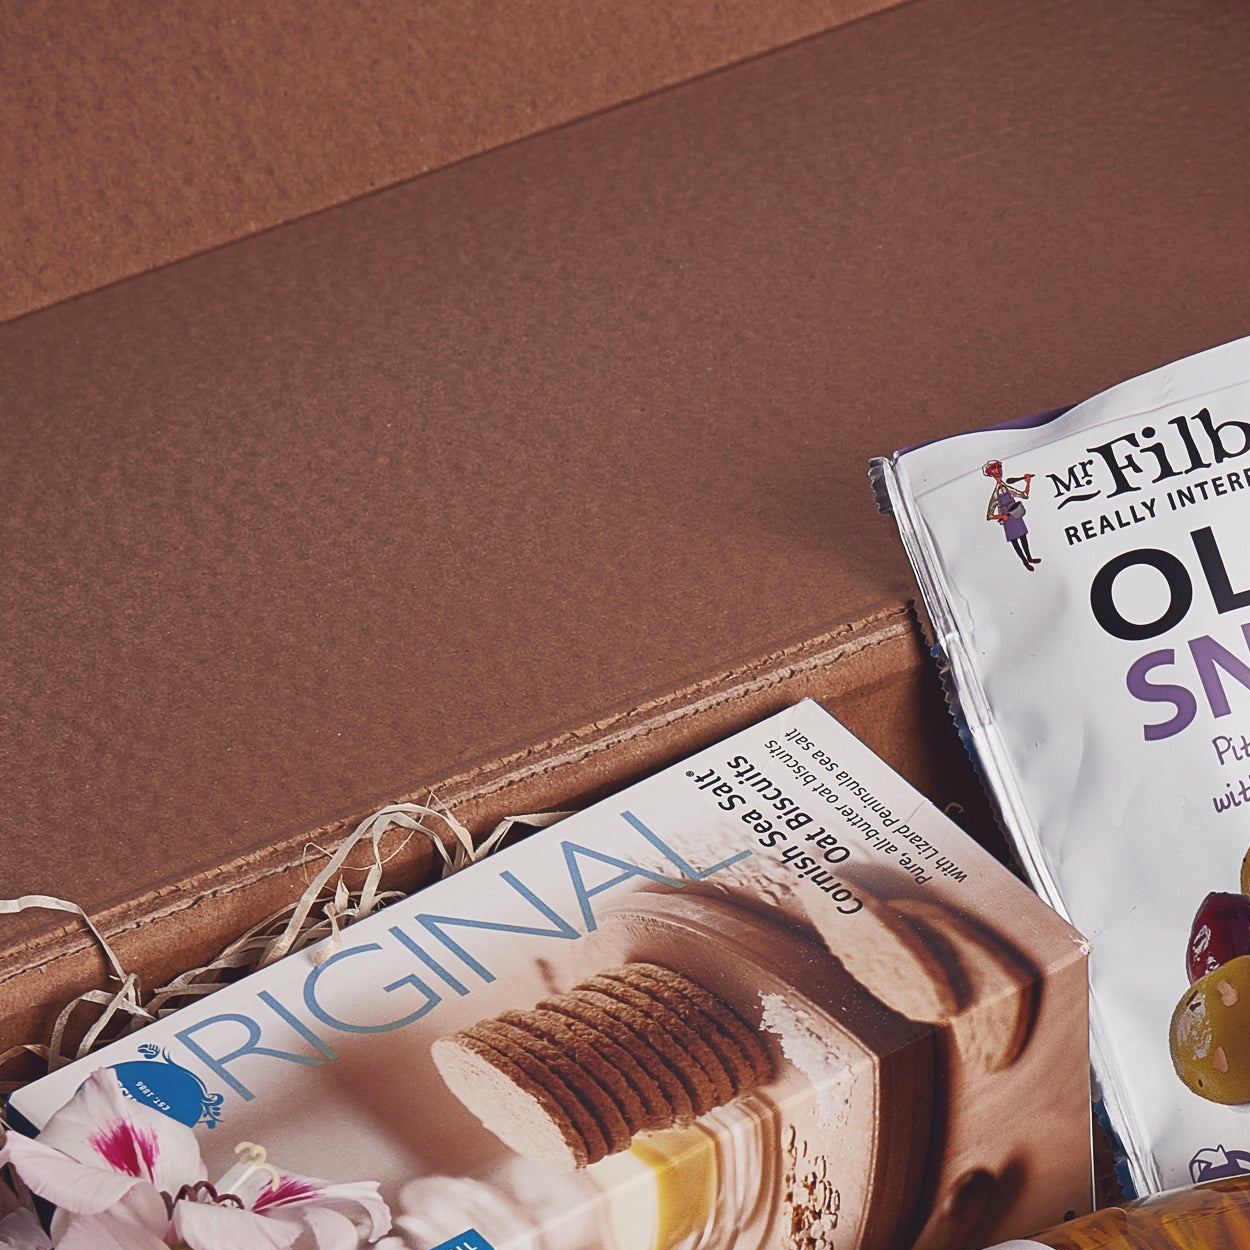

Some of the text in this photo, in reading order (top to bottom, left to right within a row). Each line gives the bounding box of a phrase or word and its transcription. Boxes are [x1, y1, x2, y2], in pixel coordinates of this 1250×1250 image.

[1064, 498, 1158, 546] REALLY
[726, 755, 850, 864] Oat Biscuits
[741, 808, 788, 848] Sea
[764, 738, 933, 886] Pure, all-butter oat biscuits
[784, 727, 968, 884] with Lizard Peninsula sea salt
[780, 844, 864, 915] Cornish
[120, 810, 753, 1122] RIGINAL
